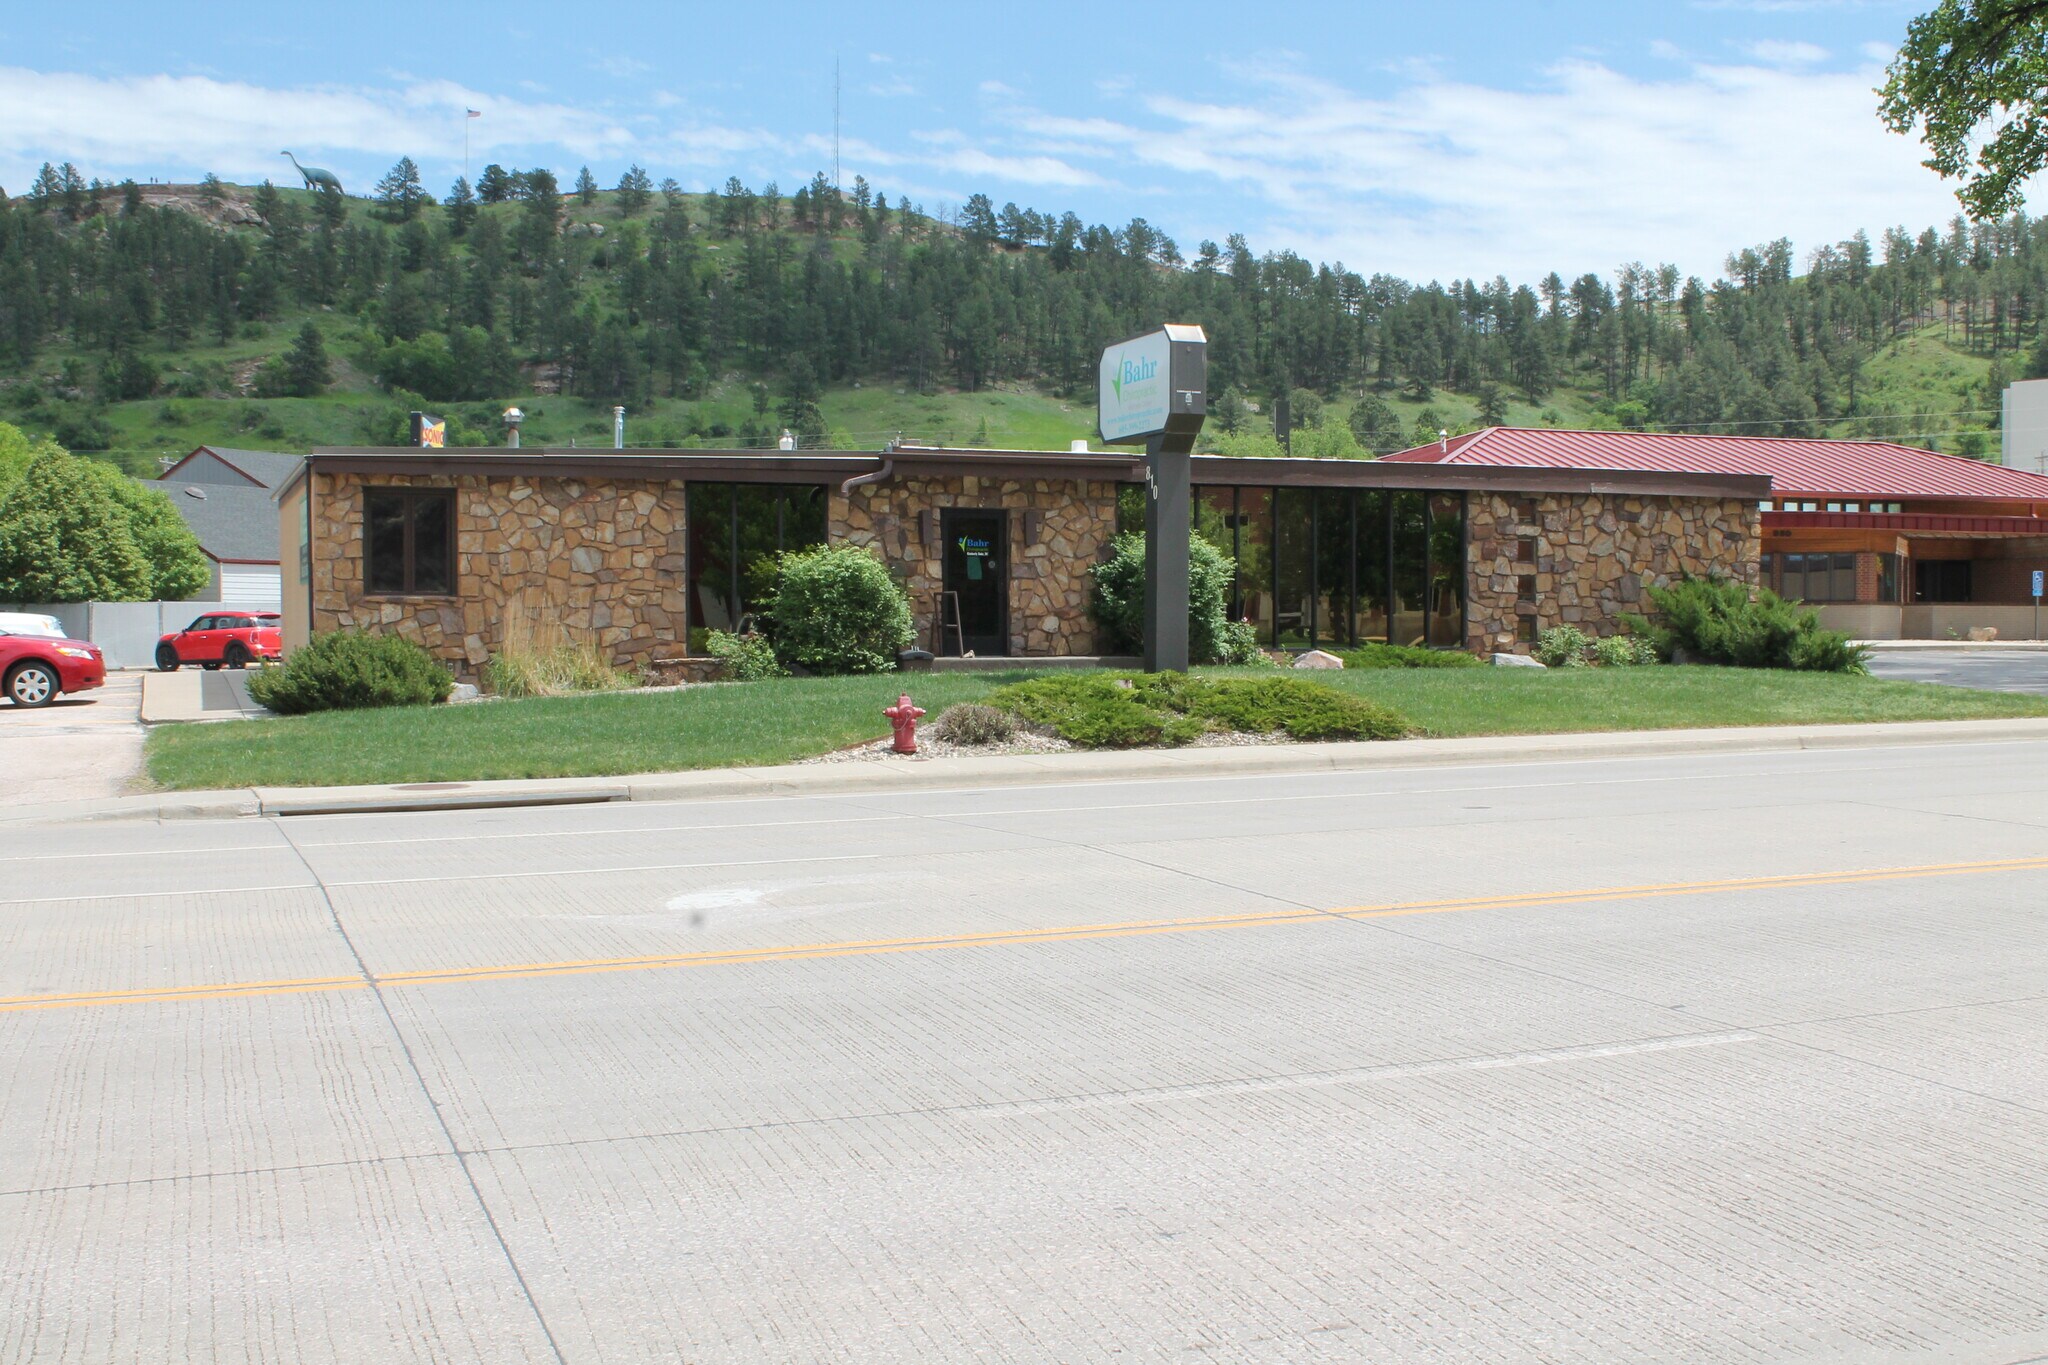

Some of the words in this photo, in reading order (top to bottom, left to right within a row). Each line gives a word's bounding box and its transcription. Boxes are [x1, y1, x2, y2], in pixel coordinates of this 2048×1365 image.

[1123, 356, 1157, 384] Bahr
[1146, 465, 1158, 500] 810
[967, 539, 989, 547] Bahr
